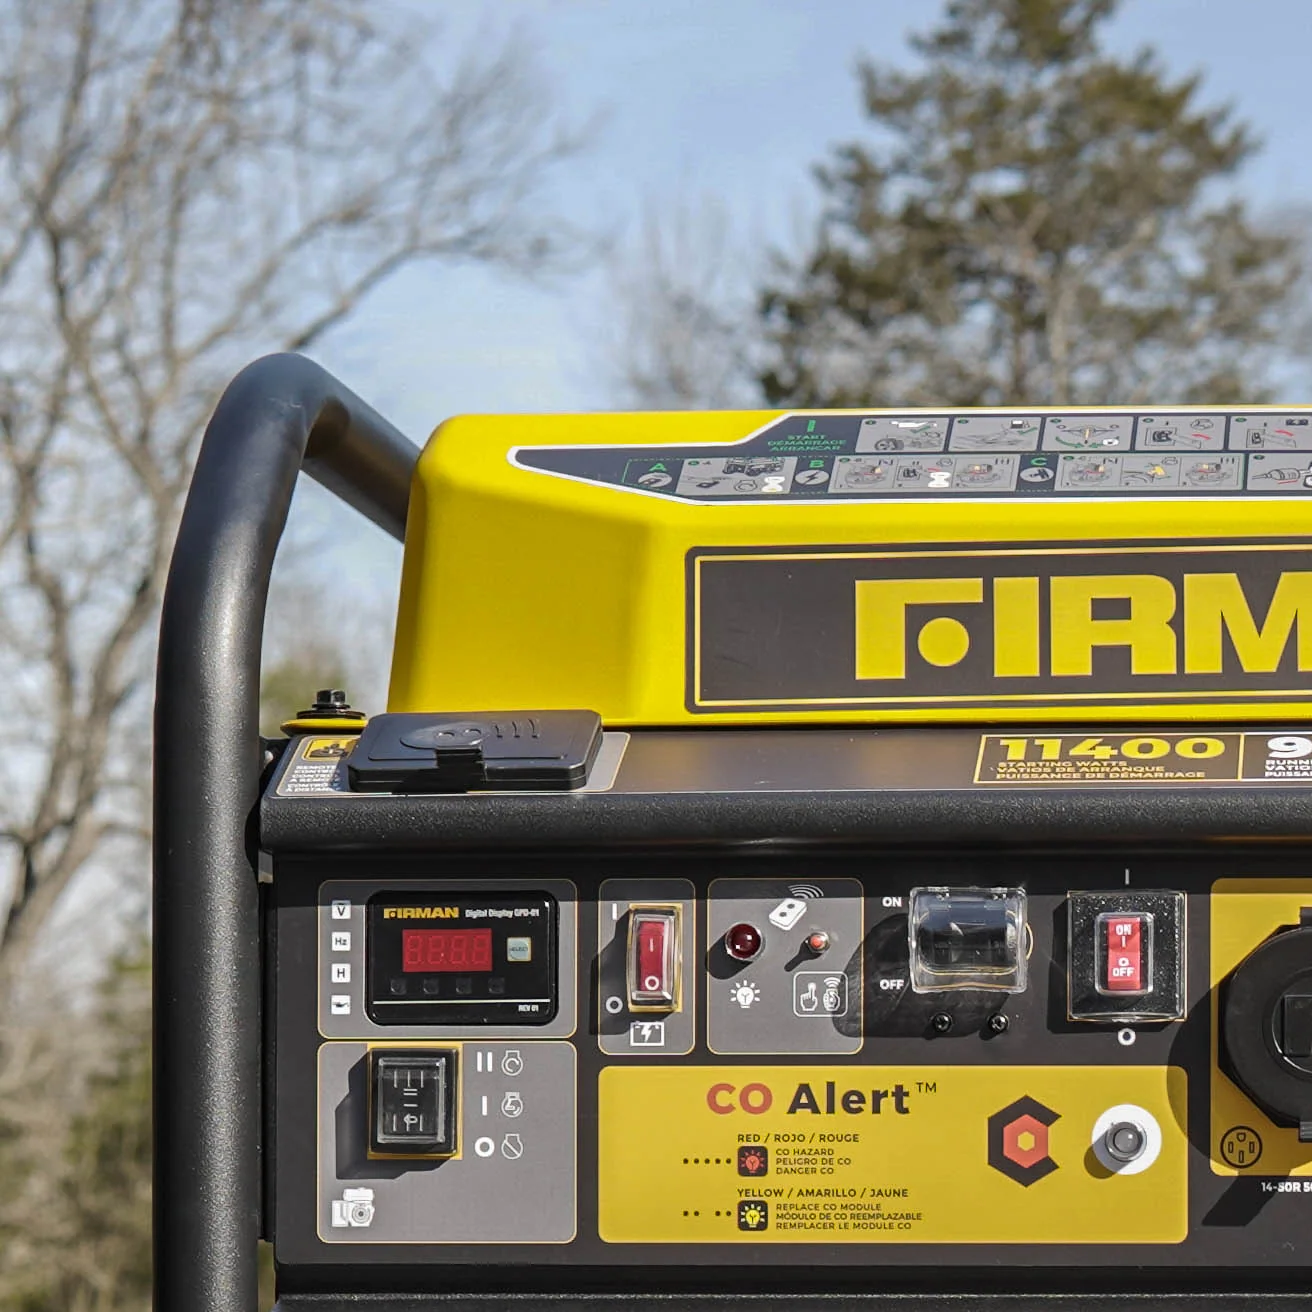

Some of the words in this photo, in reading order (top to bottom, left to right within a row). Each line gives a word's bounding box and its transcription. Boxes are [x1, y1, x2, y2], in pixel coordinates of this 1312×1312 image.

[999, 737, 1226, 761] 11400
[882, 896, 902, 907] ON
[383, 907, 459, 919] FIRMAN
[1115, 923, 1131, 937] ON
[335, 937, 347, 946] Hz
[337, 967, 345, 978] H
[1112, 967, 1134, 976] OFF
[879, 979, 904, 989] OFF
[706, 1083, 773, 1115] CO
[737, 1133, 760, 1142] RED
[773, 1133, 805, 1142] ROJO
[818, 1133, 859, 1142] ROUGE
[775, 1148, 790, 1156] CO
[793, 1148, 834, 1156] HAZARD
[775, 1157, 817, 1165] PELIGRO
[821, 1157, 834, 1165] DE
[837, 1157, 851, 1165] CO
[1261, 1181, 1301, 1192] 14-50R
[737, 1188, 784, 1197] YELLOW
[796, 1188, 856, 1197] AMARILLO
[870, 1188, 908, 1197] JAUNE
[776, 1203, 819, 1211] REPLACE
[822, 1203, 837, 1211] CO
[840, 1203, 881, 1211] MODULE
[776, 1210, 817, 1220] MÓDULO
[819, 1212, 832, 1220] DE
[833, 1212, 847, 1220] CO
[849, 1212, 922, 1220] REEMPLAZABLE
